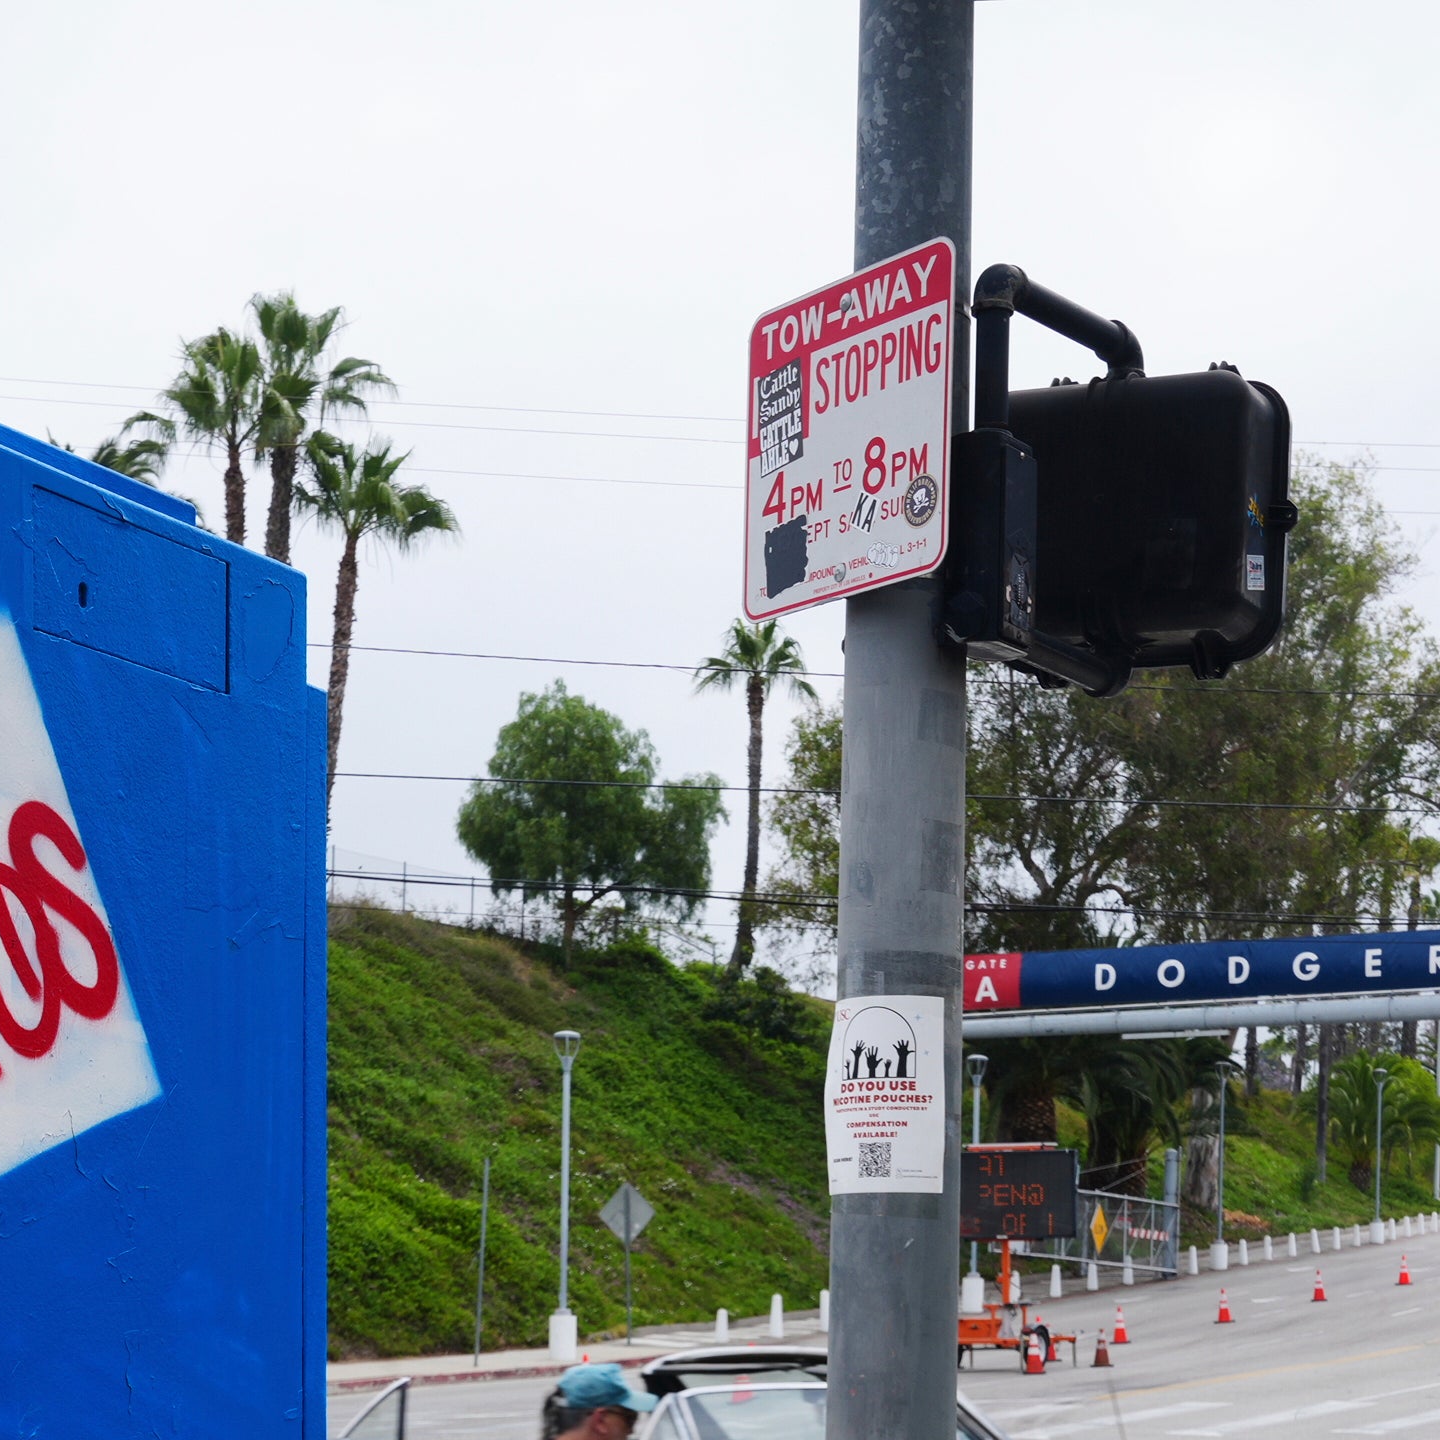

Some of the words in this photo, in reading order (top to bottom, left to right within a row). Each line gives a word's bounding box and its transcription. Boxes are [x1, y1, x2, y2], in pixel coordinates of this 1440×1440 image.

[762, 254, 938, 361] TOW-AWAY
[814, 312, 942, 415] STOPPING
[760, 363, 799, 399] Cattle
[759, 387, 801, 424] Sandy
[760, 408, 802, 452] CATTLE
[762, 471, 823, 525] 4PM
[832, 457, 853, 485] TO
[862, 436, 928, 495] 8PM
[965, 957, 1008, 971] GATE
[975, 979, 998, 1002] A
[841, 1083, 855, 1094] DO
[857, 1081, 886, 1092] YOU
[889, 1081, 917, 1091] USE
[873, 1094, 934, 1104] POUCHES?
[846, 1120, 908, 1129] COMPENSATION
[853, 1131, 898, 1139] AVAILABLE!
